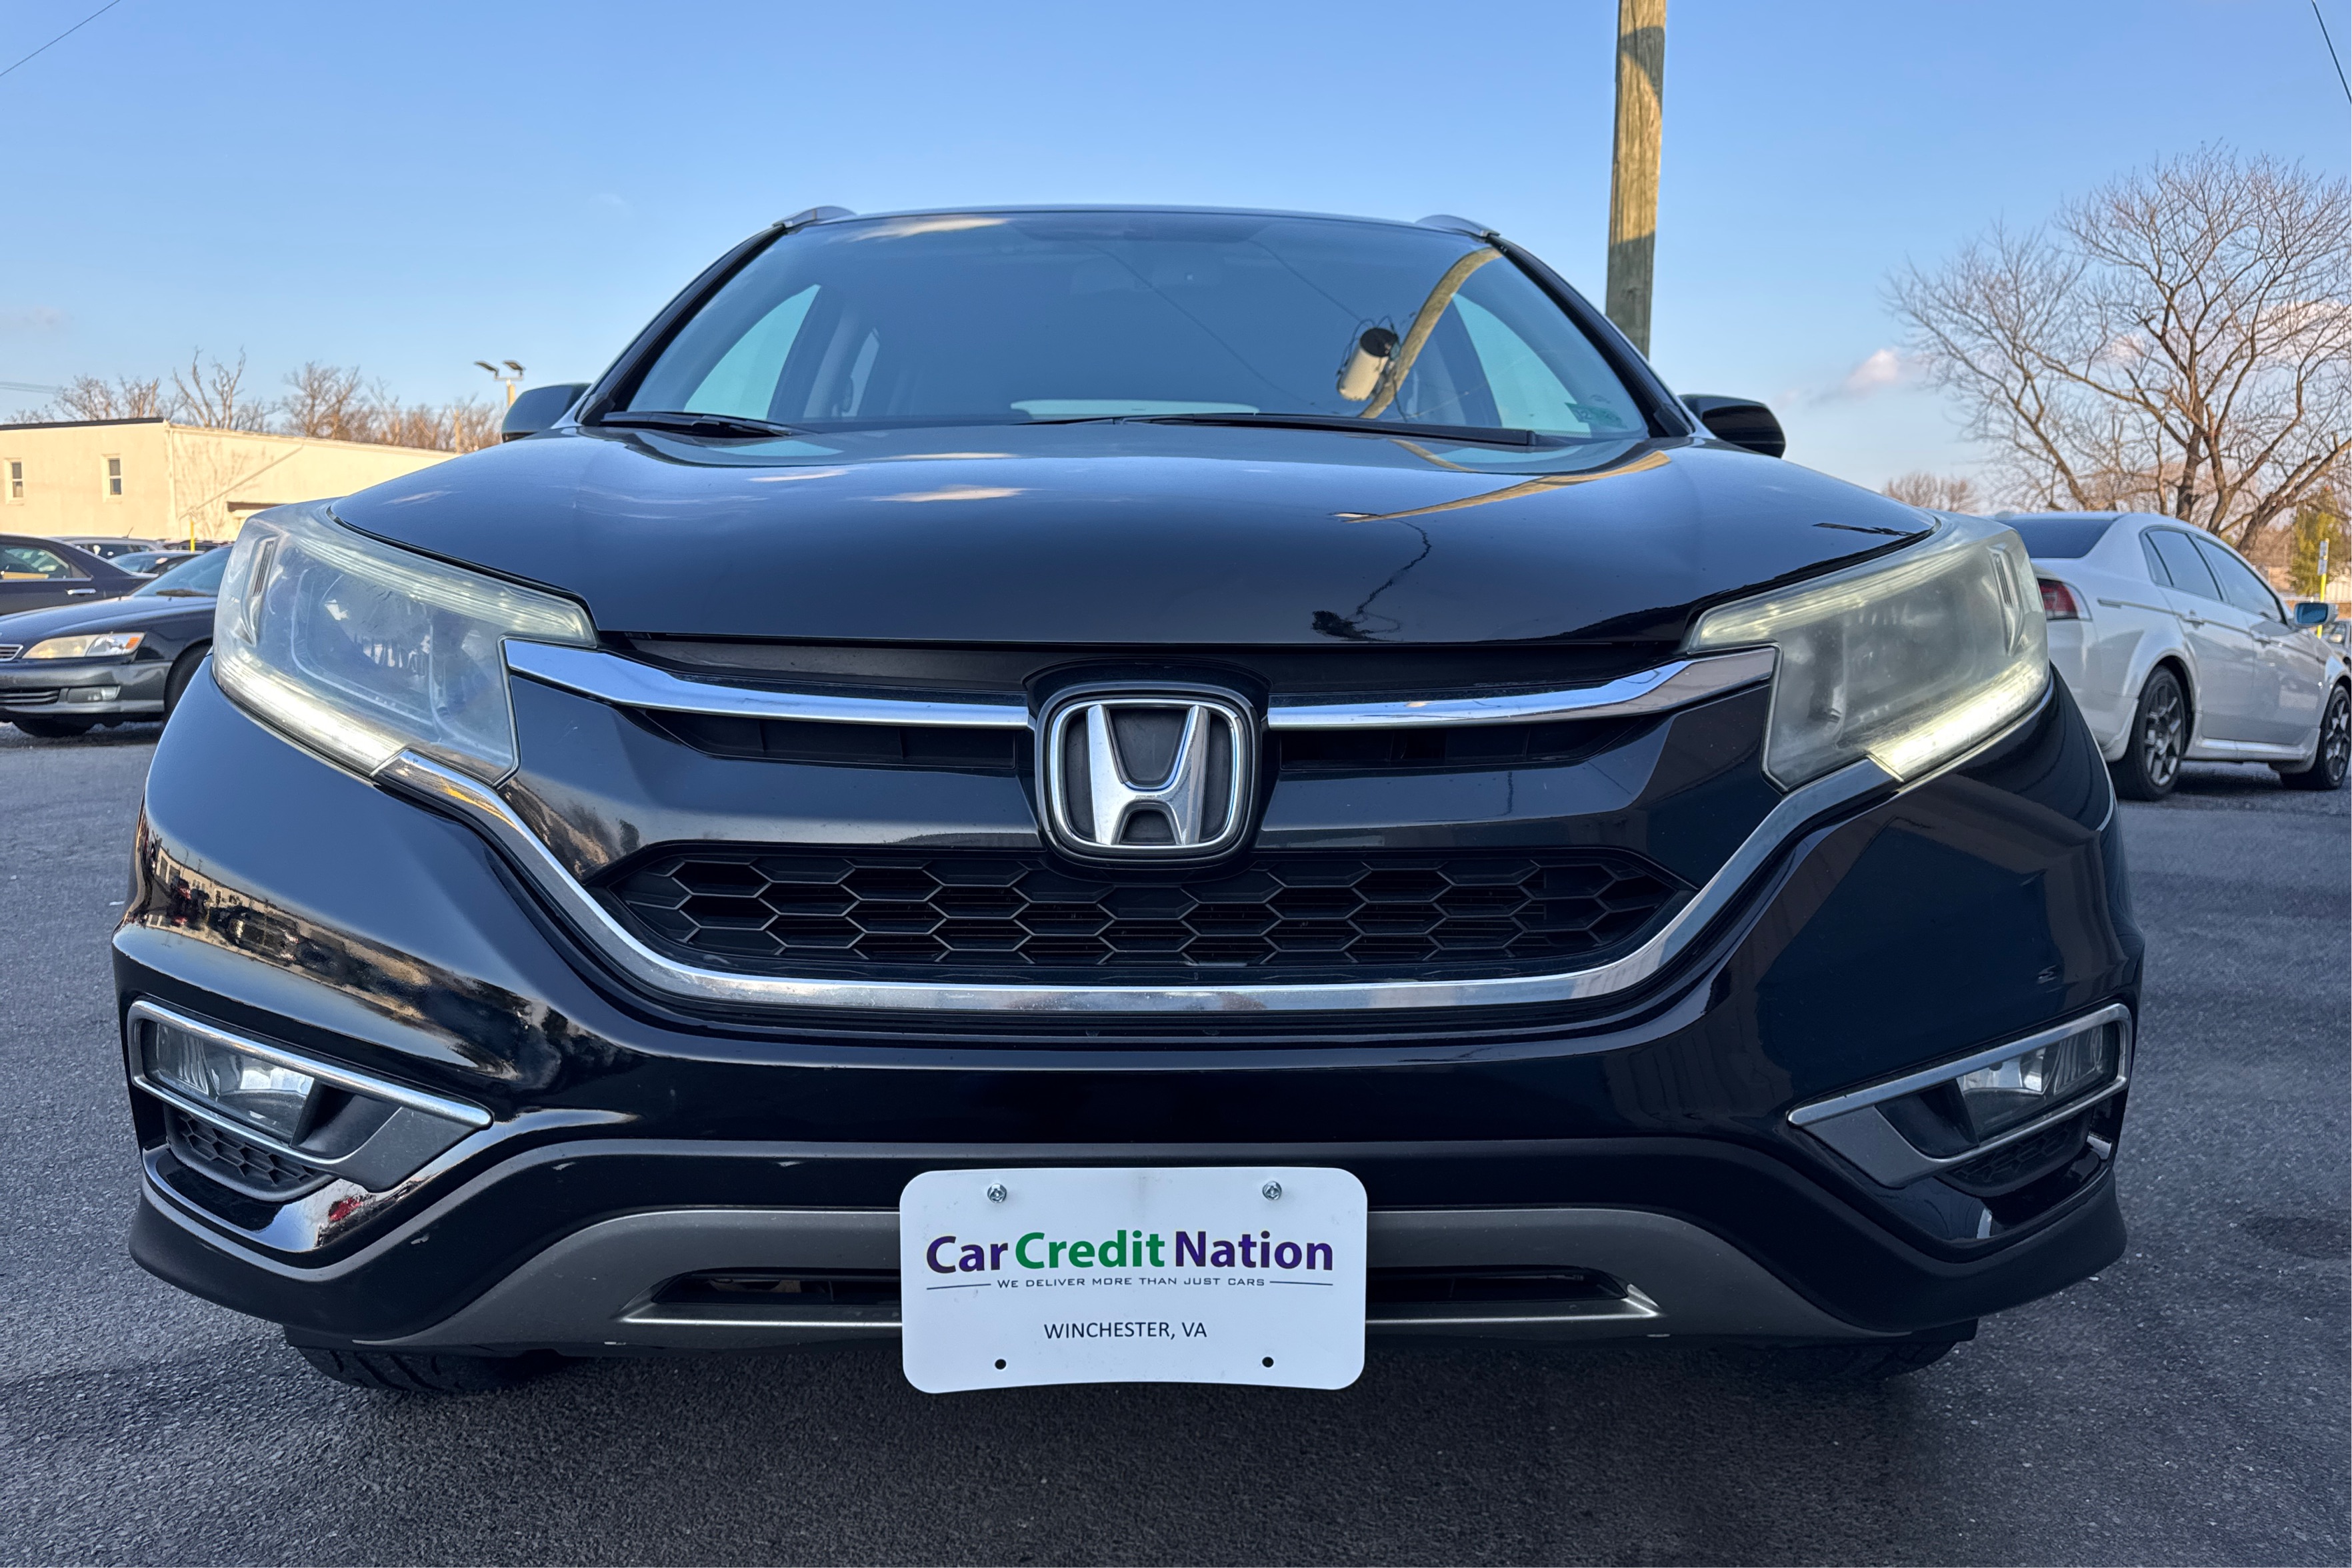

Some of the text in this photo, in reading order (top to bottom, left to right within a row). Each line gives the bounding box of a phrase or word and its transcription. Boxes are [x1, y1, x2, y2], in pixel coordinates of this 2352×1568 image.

[926, 1229, 1333, 1274] Car Credit Nation
[997, 1277, 1265, 1289] WE DELIVER MORE THAN JUST CARS
[1043, 1321, 1207, 1341] WINCHESTER, VA
